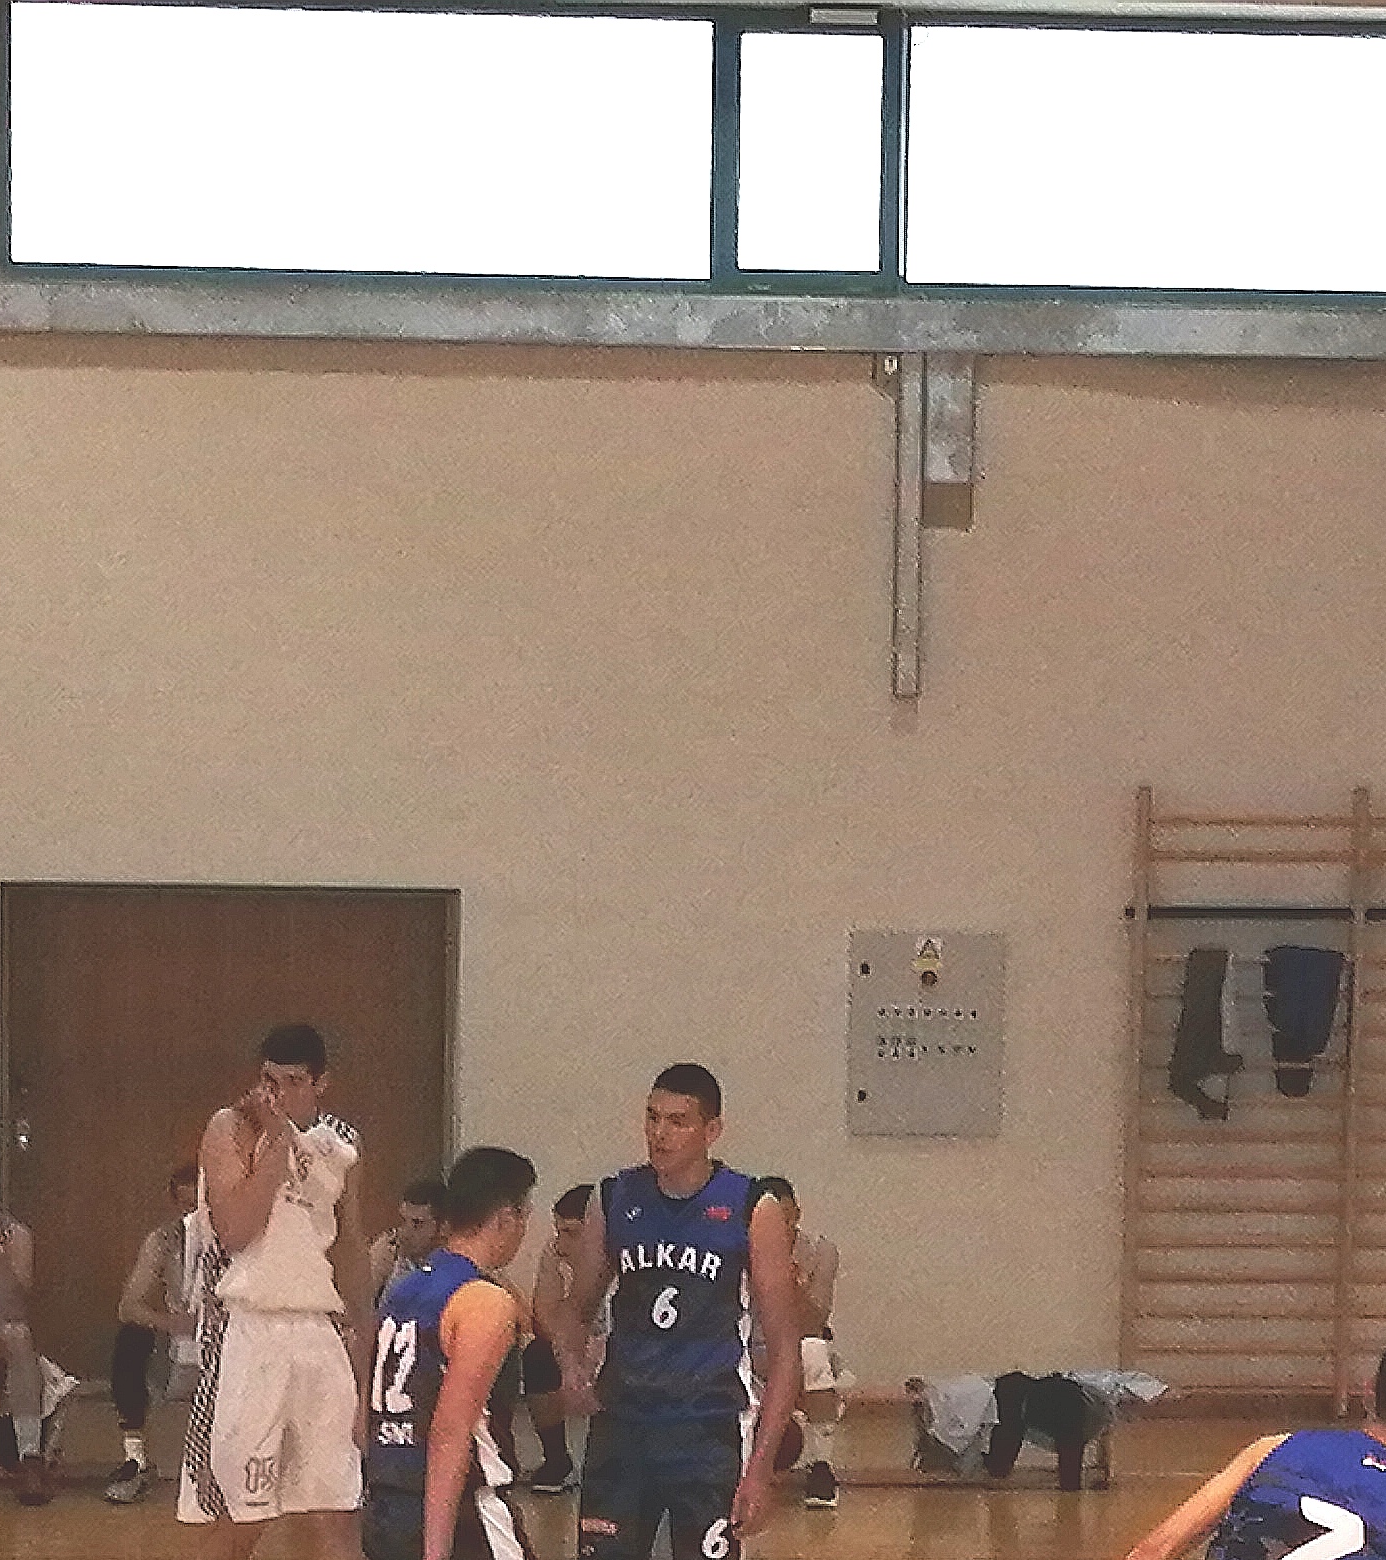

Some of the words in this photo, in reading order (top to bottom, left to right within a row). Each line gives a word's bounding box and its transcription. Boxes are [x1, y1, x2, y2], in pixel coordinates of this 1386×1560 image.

[620, 1243, 723, 1281] ALKAR
[652, 1287, 679, 1328] 6
[371, 1315, 416, 1413] 12
[701, 1517, 730, 1560] 6
